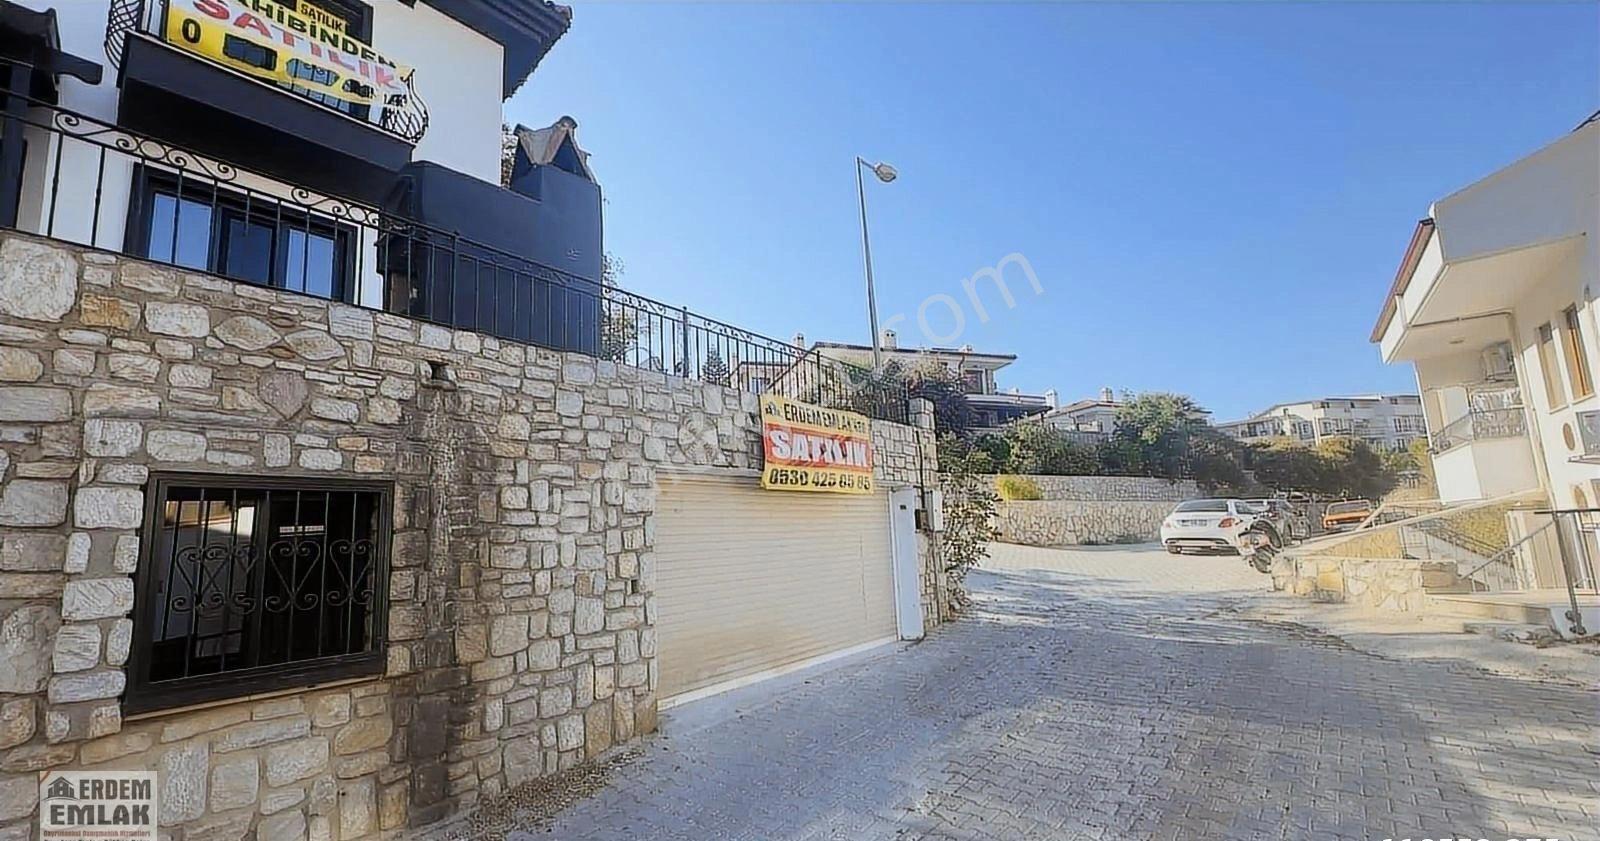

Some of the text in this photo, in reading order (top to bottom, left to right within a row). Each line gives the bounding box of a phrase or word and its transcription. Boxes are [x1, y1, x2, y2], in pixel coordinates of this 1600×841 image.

[300, 3, 342, 31] SATILIK
[192, 0, 401, 90] SATILIK
[783, 403, 822, 426] ERDEM
[769, 468, 809, 486] 0530
[812, 472, 837, 487] 425
